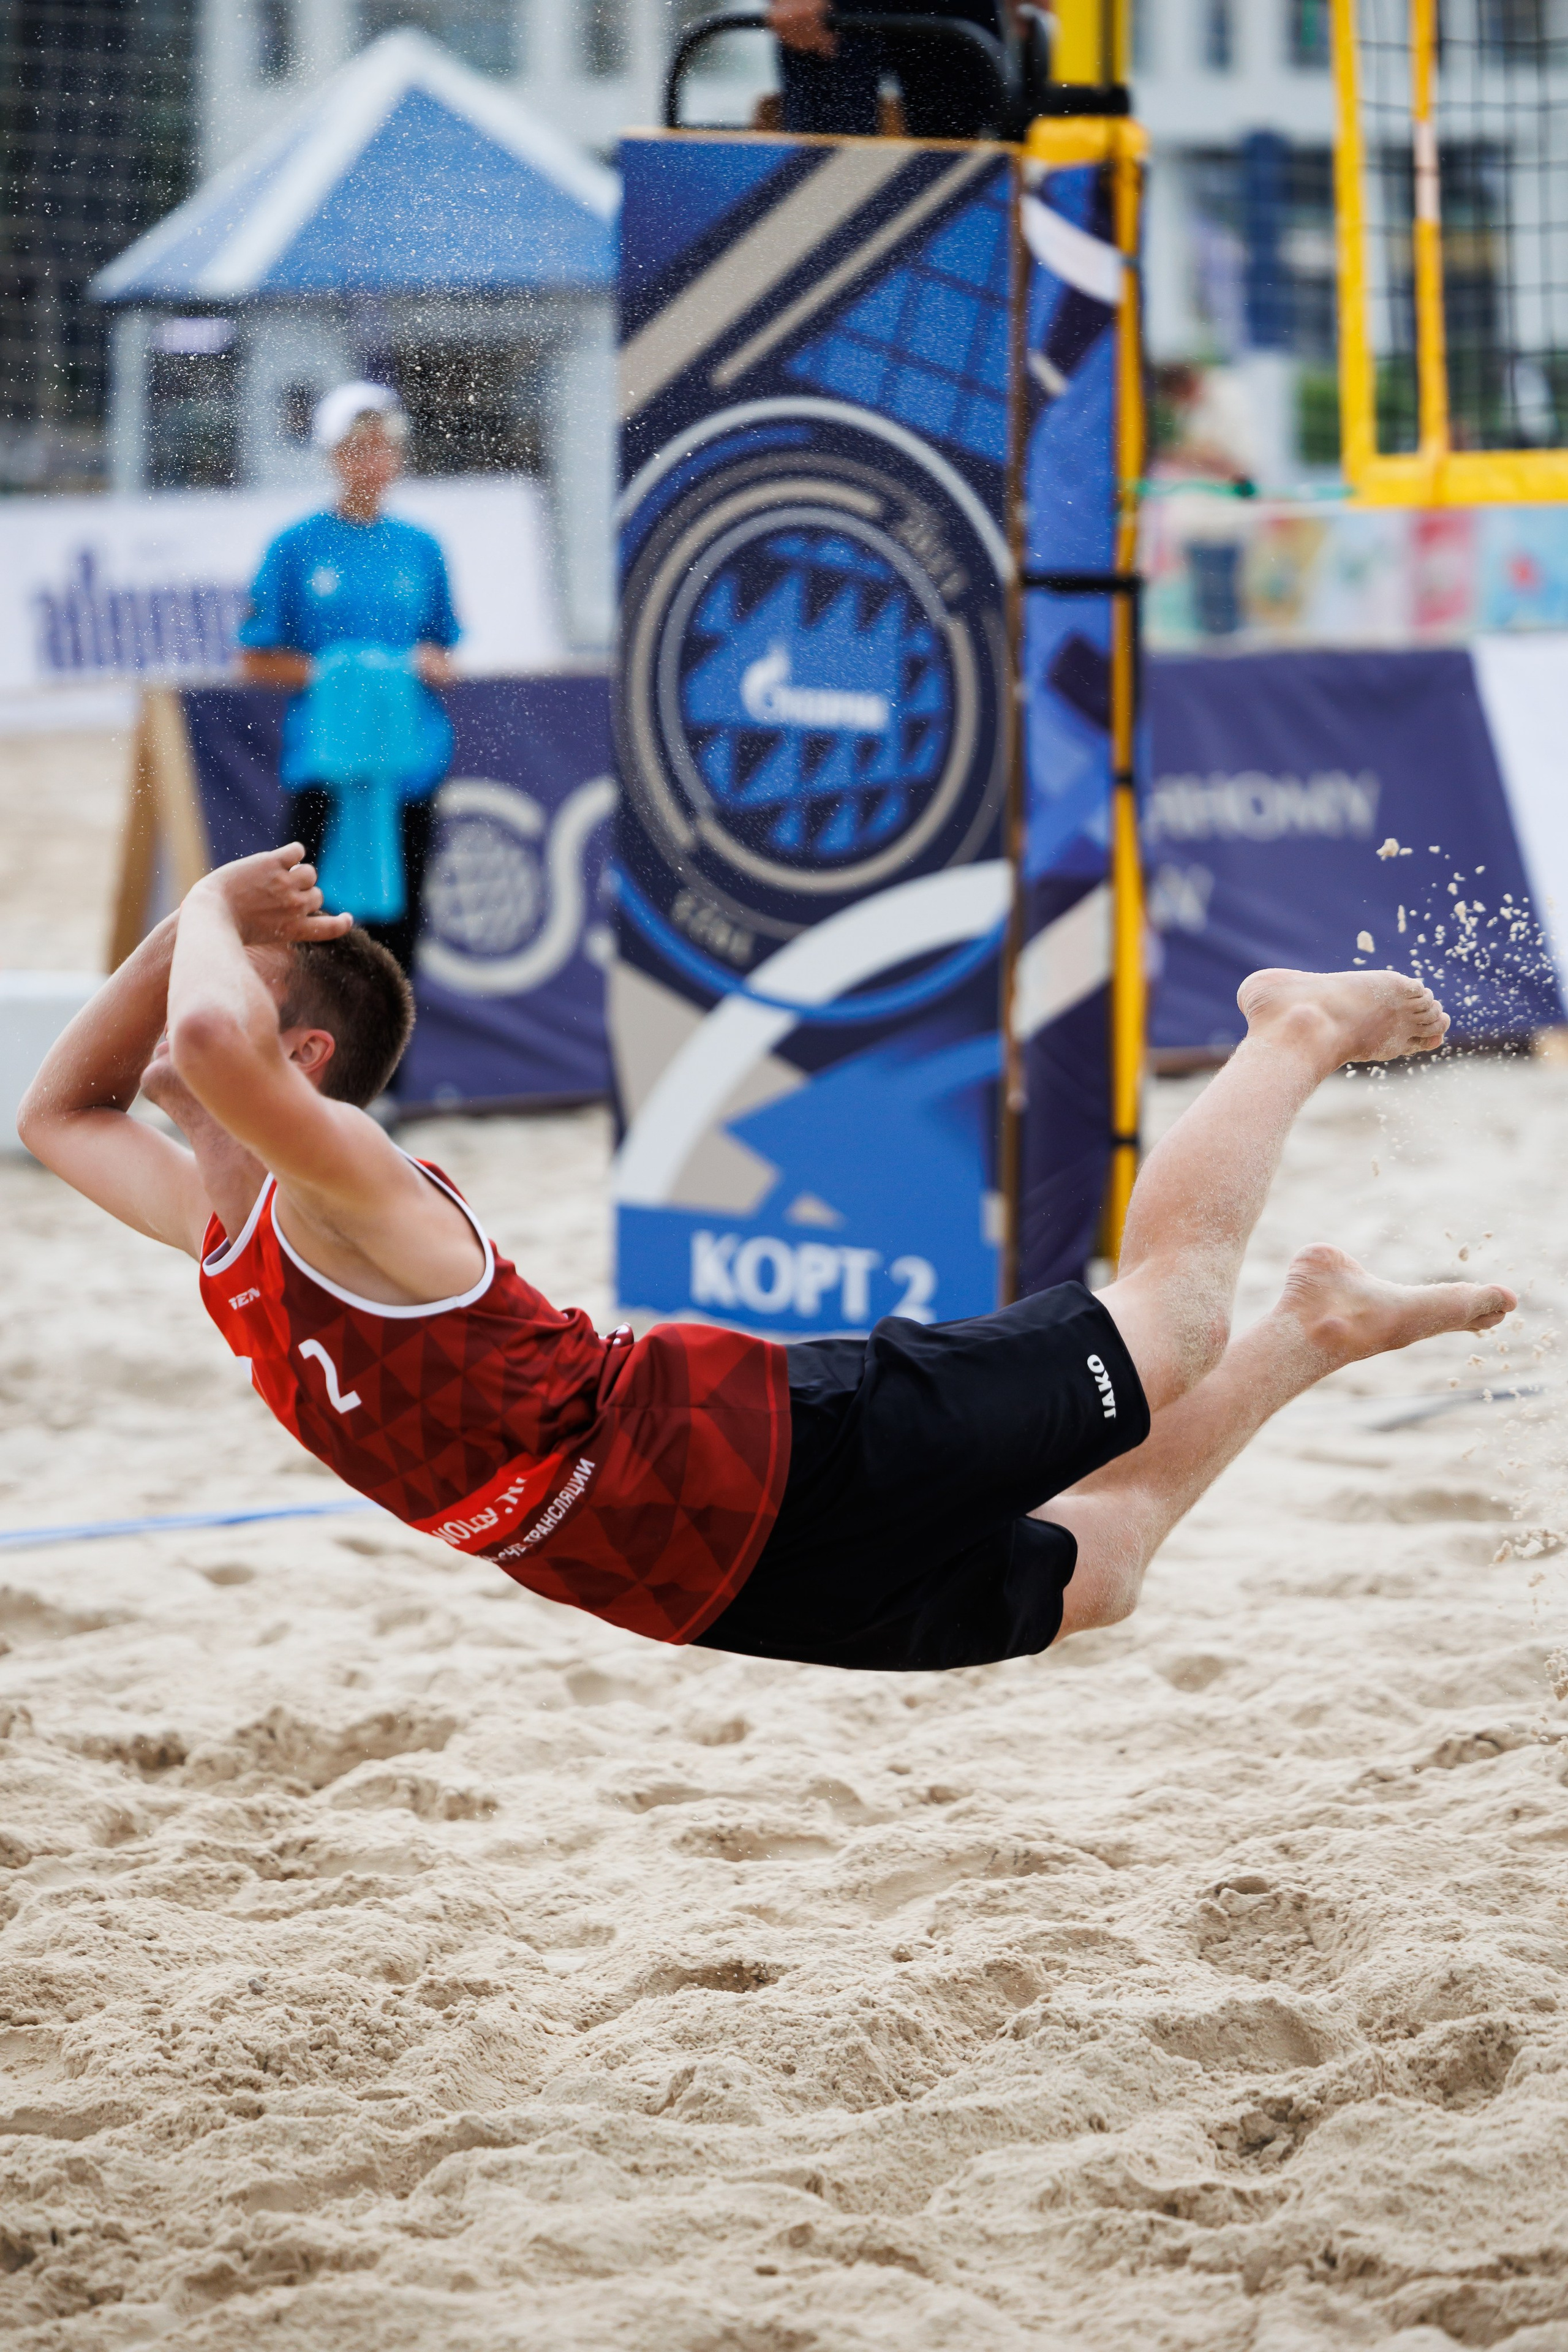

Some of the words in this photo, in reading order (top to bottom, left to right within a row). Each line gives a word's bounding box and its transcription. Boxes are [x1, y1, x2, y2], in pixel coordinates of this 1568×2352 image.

[691, 1231, 881, 1323] КОРТ
[890, 1256, 937, 1324] 2
[298, 1339, 362, 1414] 2
[1087, 1354, 1116, 1418] JAKO
[523, 1458, 595, 1543] ТРАНСЛЯЦИИ
